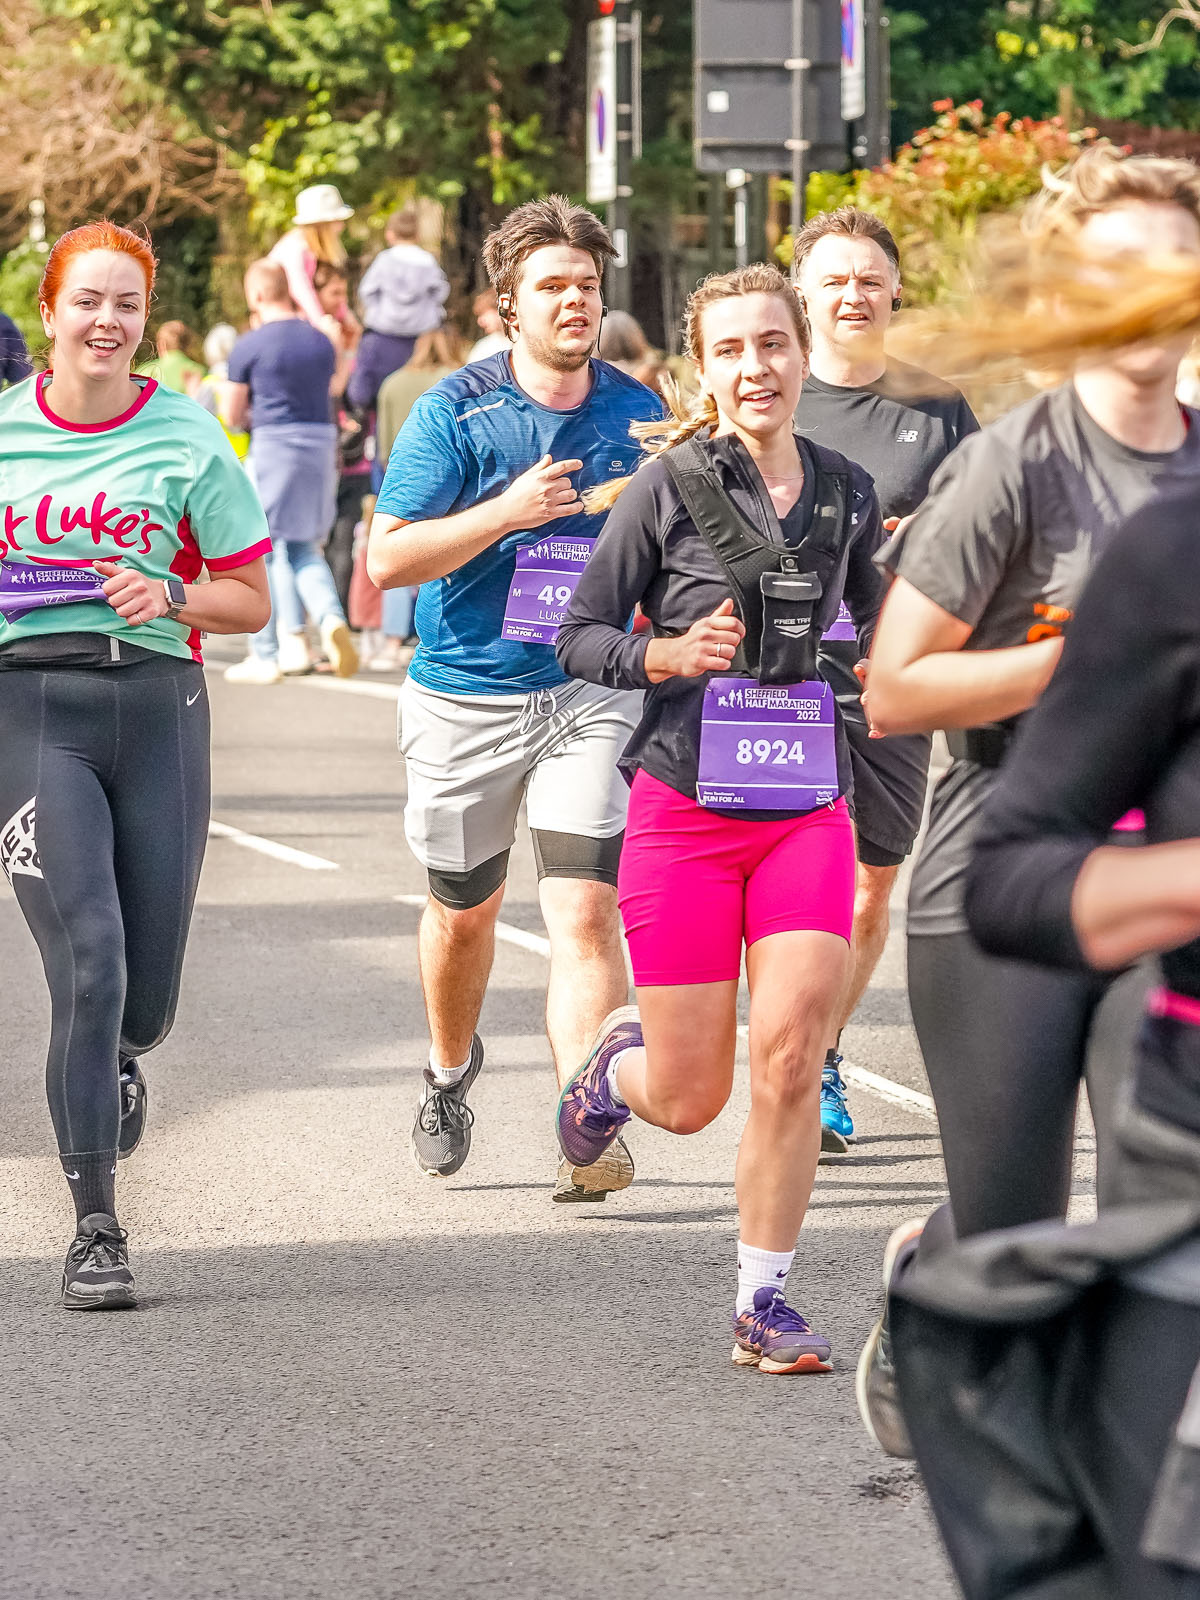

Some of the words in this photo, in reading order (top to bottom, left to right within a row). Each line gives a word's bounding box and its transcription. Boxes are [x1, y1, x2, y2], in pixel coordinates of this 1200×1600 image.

[35, 491, 164, 555] Luke's
[551, 543, 589, 553] SHEFFIELD
[551, 552, 571, 560] HALF
[572, 553, 590, 561] MAR
[37, 570, 85, 578] SHEFFIELD
[512, 588, 521, 597] M
[537, 585, 572, 607] 49
[746, 689, 787, 699] SHEFFIELD
[745, 700, 768, 708] HALF
[769, 700, 820, 709] MARATHON
[796, 711, 821, 720] 2022
[736, 739, 805, 765] 8924
